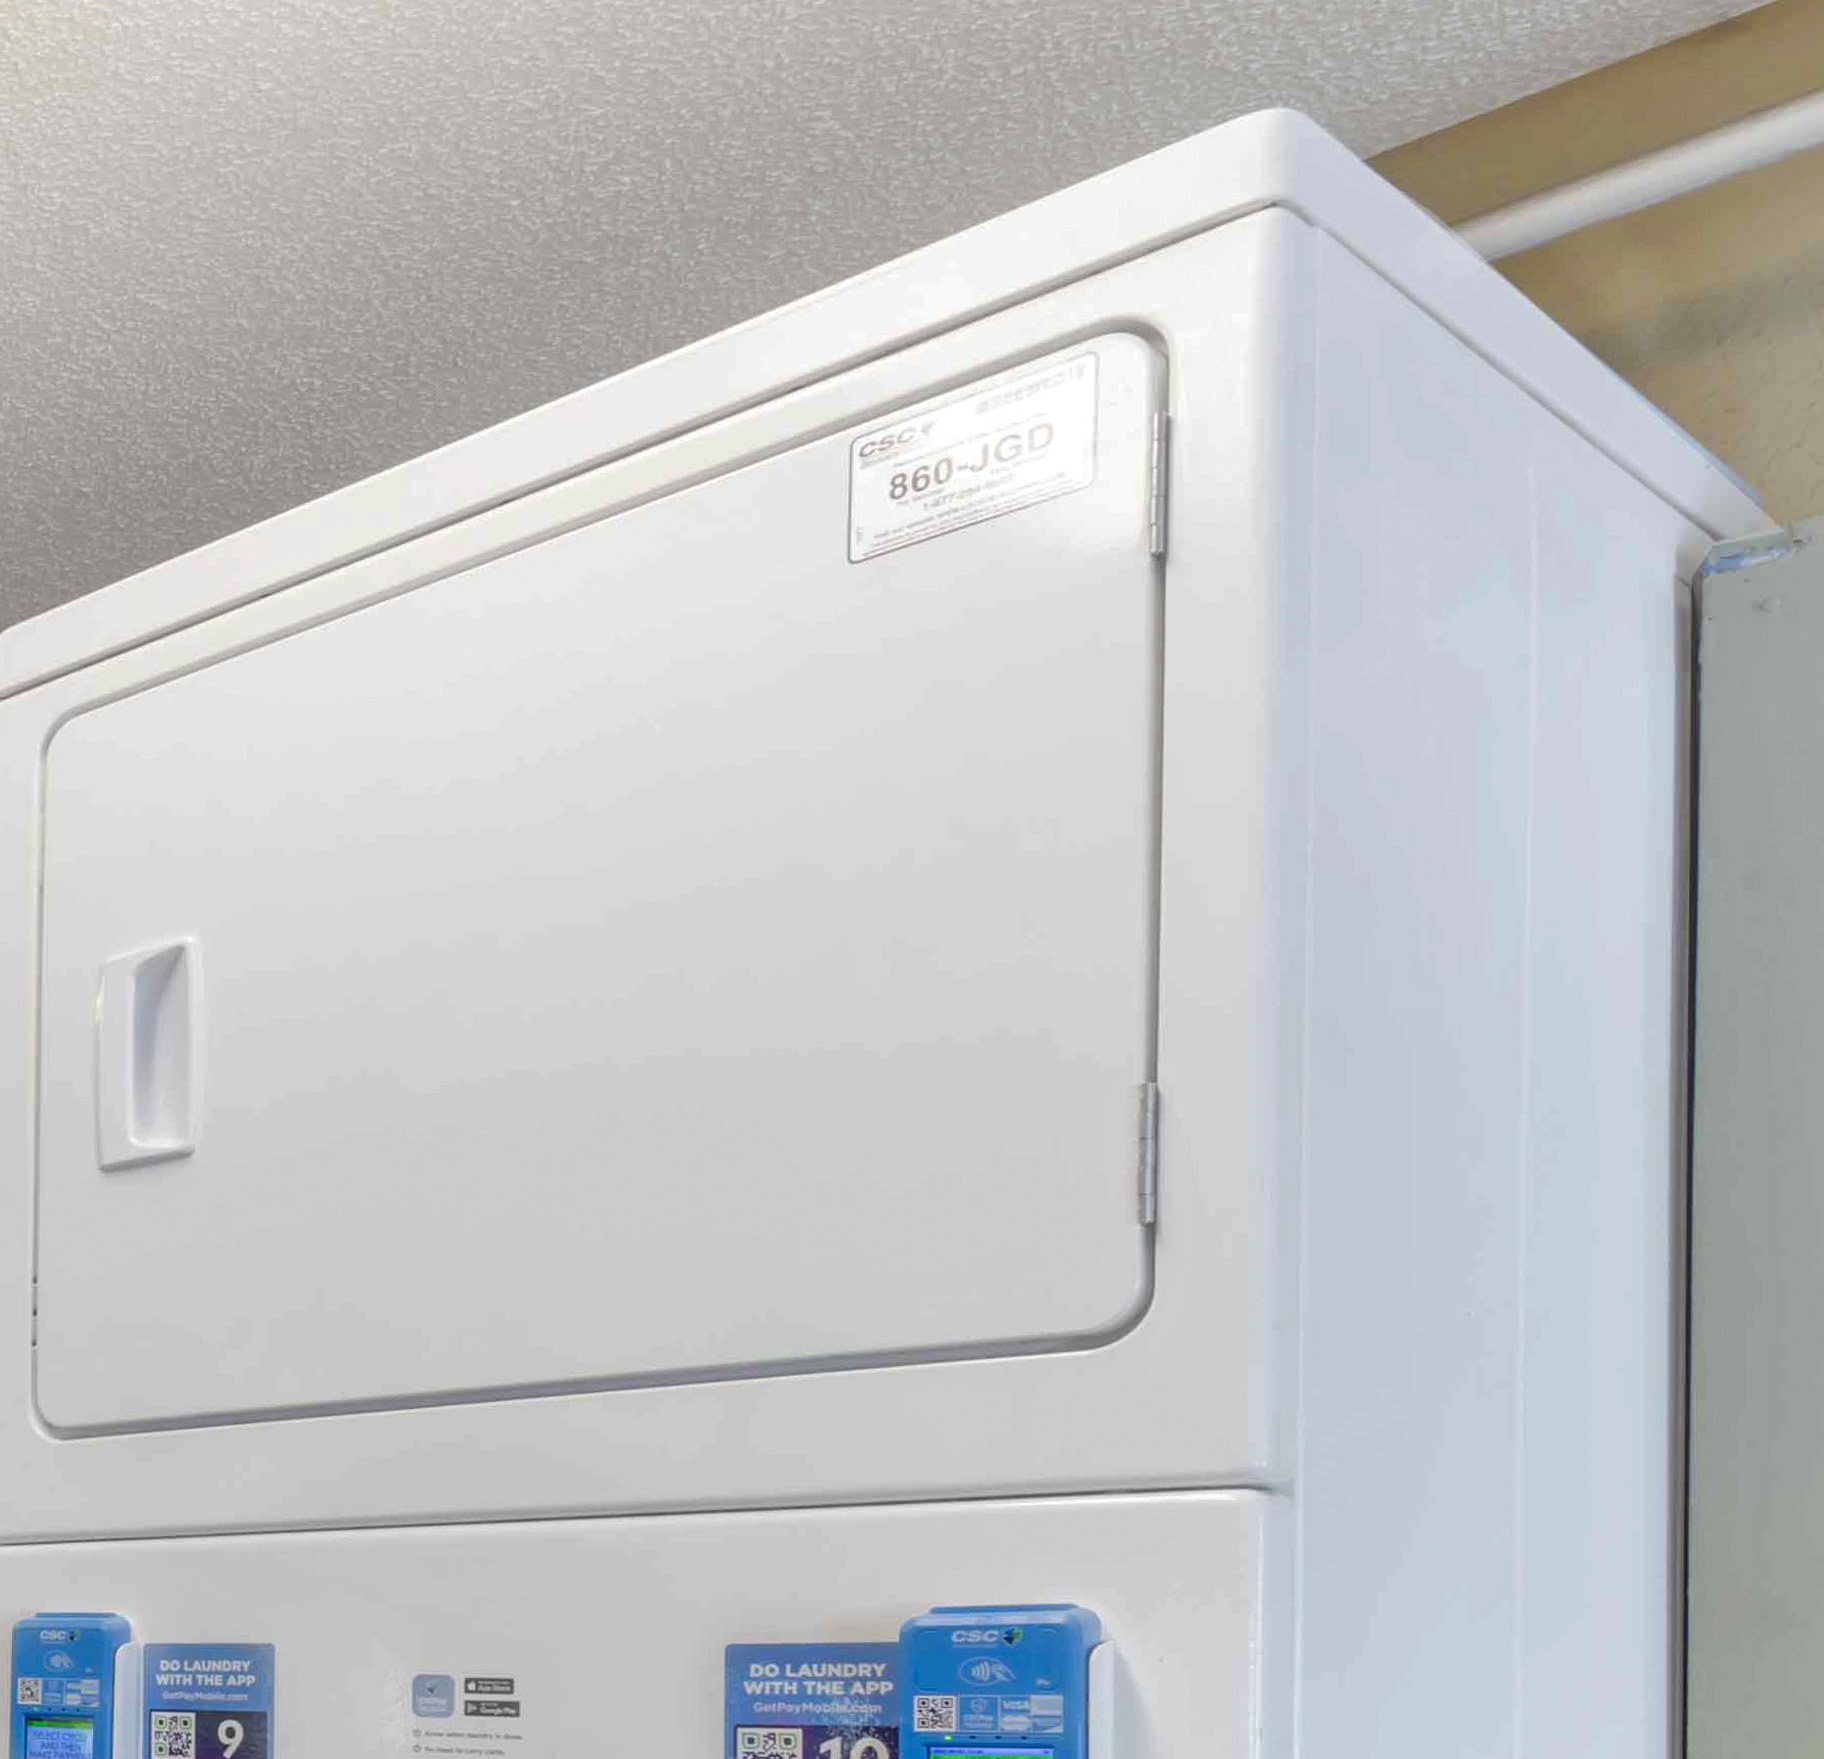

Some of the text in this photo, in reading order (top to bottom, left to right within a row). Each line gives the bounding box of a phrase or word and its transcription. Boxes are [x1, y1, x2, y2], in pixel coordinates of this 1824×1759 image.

[859, 429, 917, 458] CSC
[889, 423, 1054, 500] 860-JGD
[952, 1629, 998, 1643] CSC
[160, 1660, 250, 1672] DO LAUNDRY
[750, 1663, 887, 1678] DO LAUNDRY
[156, 1674, 256, 1687] WITH THE APP
[743, 1681, 893, 1695] WITH THE APP
[217, 1719, 245, 1759] 9
